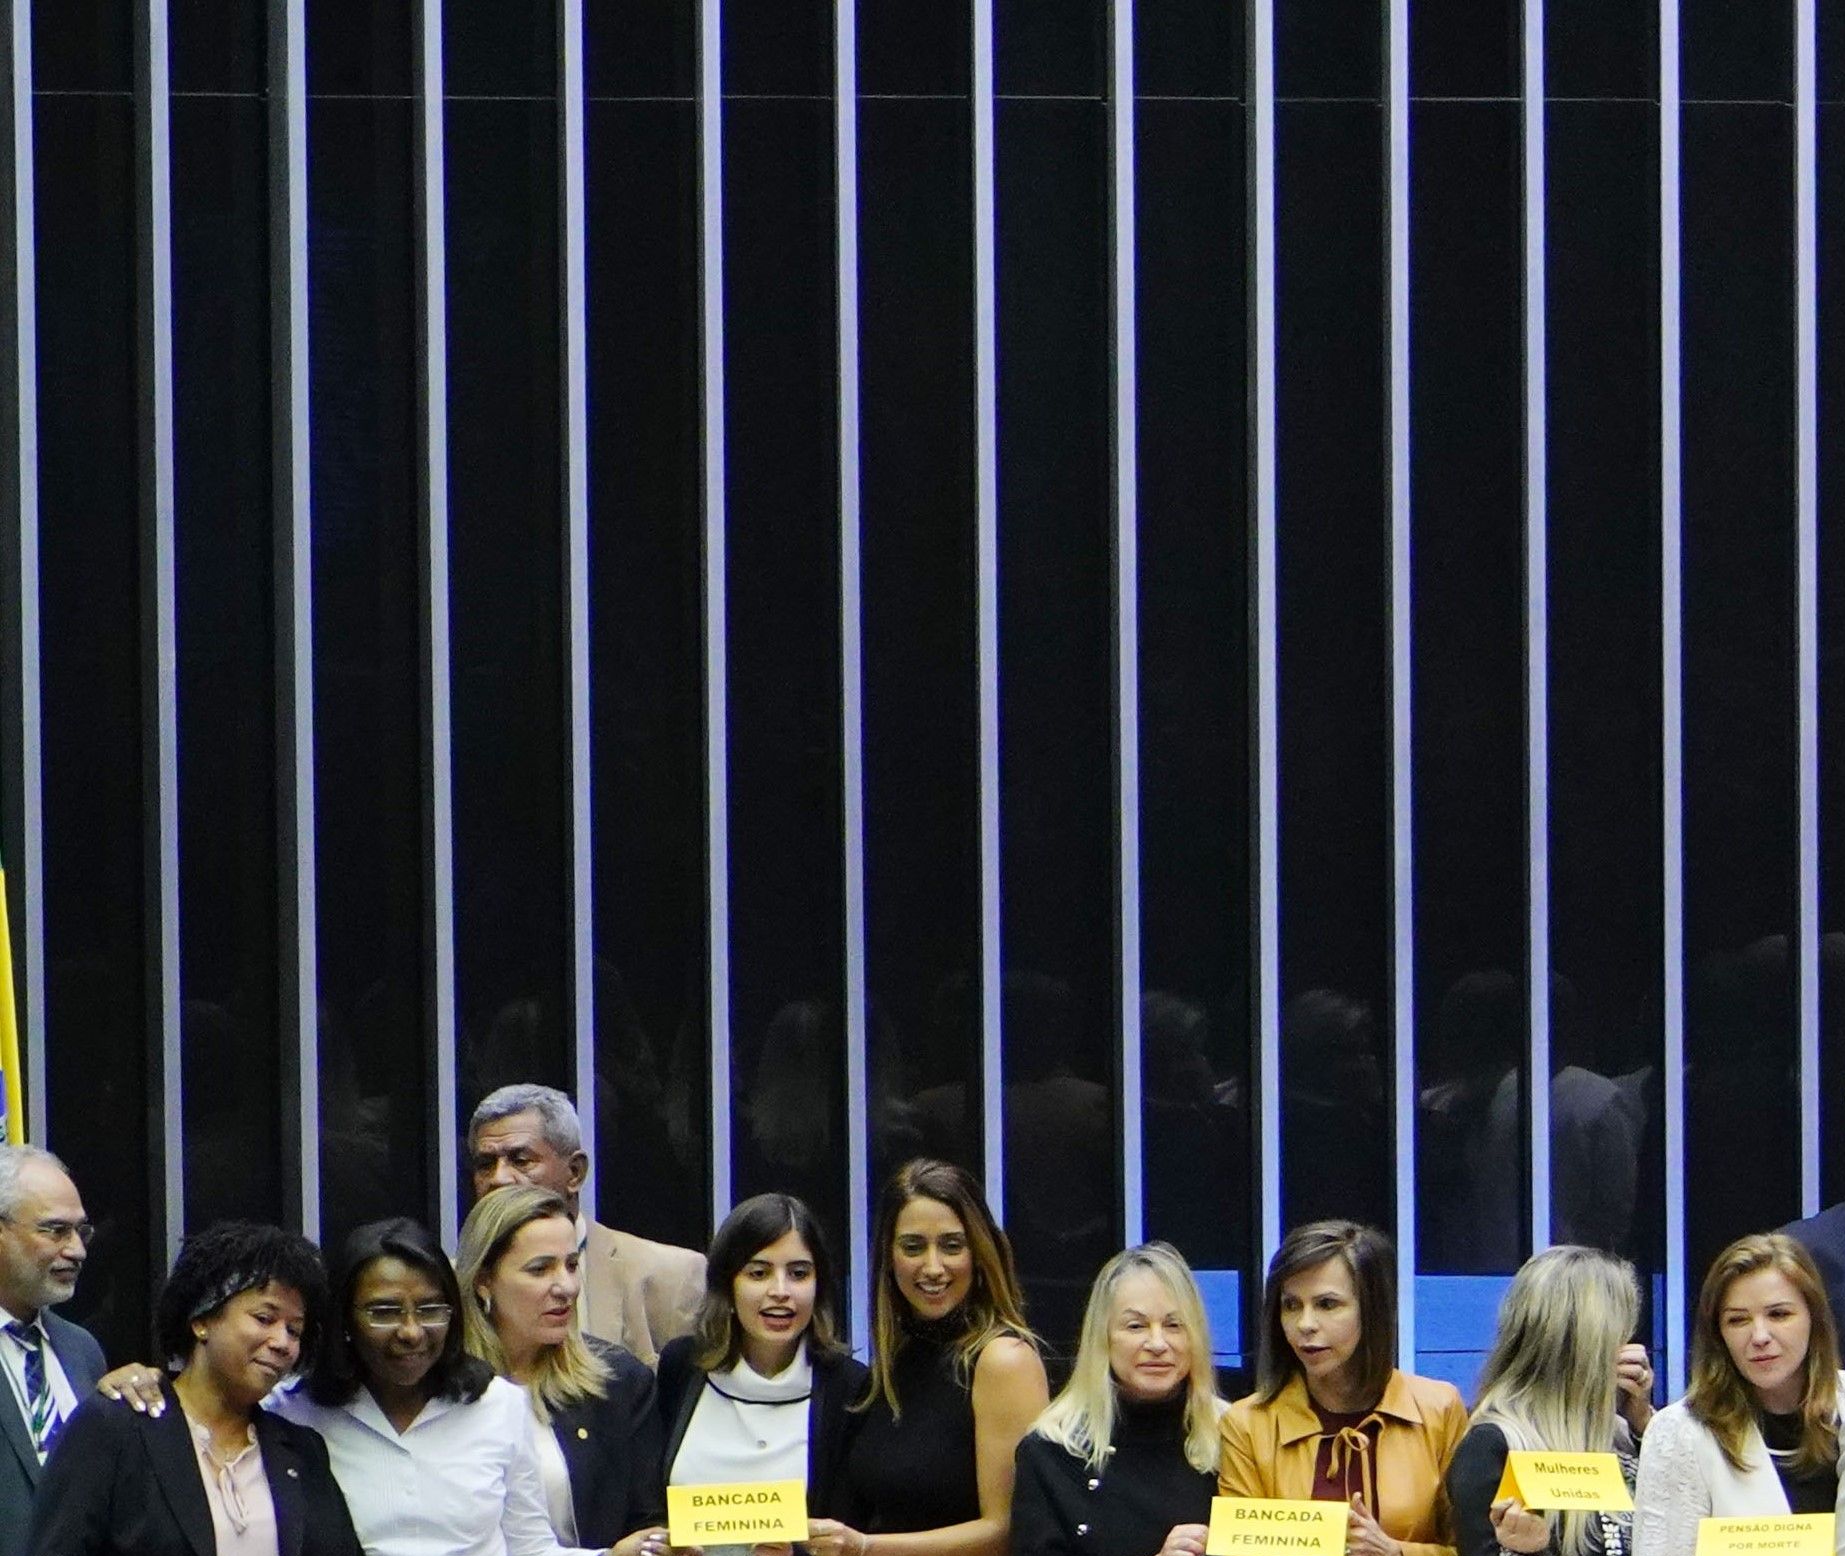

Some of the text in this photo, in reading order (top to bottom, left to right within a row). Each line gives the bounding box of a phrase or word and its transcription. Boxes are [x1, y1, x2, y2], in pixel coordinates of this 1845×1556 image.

[1534, 1462, 1600, 1475] Mulheres
[692, 1492, 782, 1507] BANCADA
[1550, 1488, 1600, 1499] Unidas
[1235, 1508, 1324, 1522] BANCADA
[694, 1518, 784, 1532] FEMININA
[1720, 1523, 1812, 1533] PENSÃO DIGNA
[1231, 1534, 1321, 1548] FEMININA
[1728, 1541, 1801, 1550] POR MORTE
